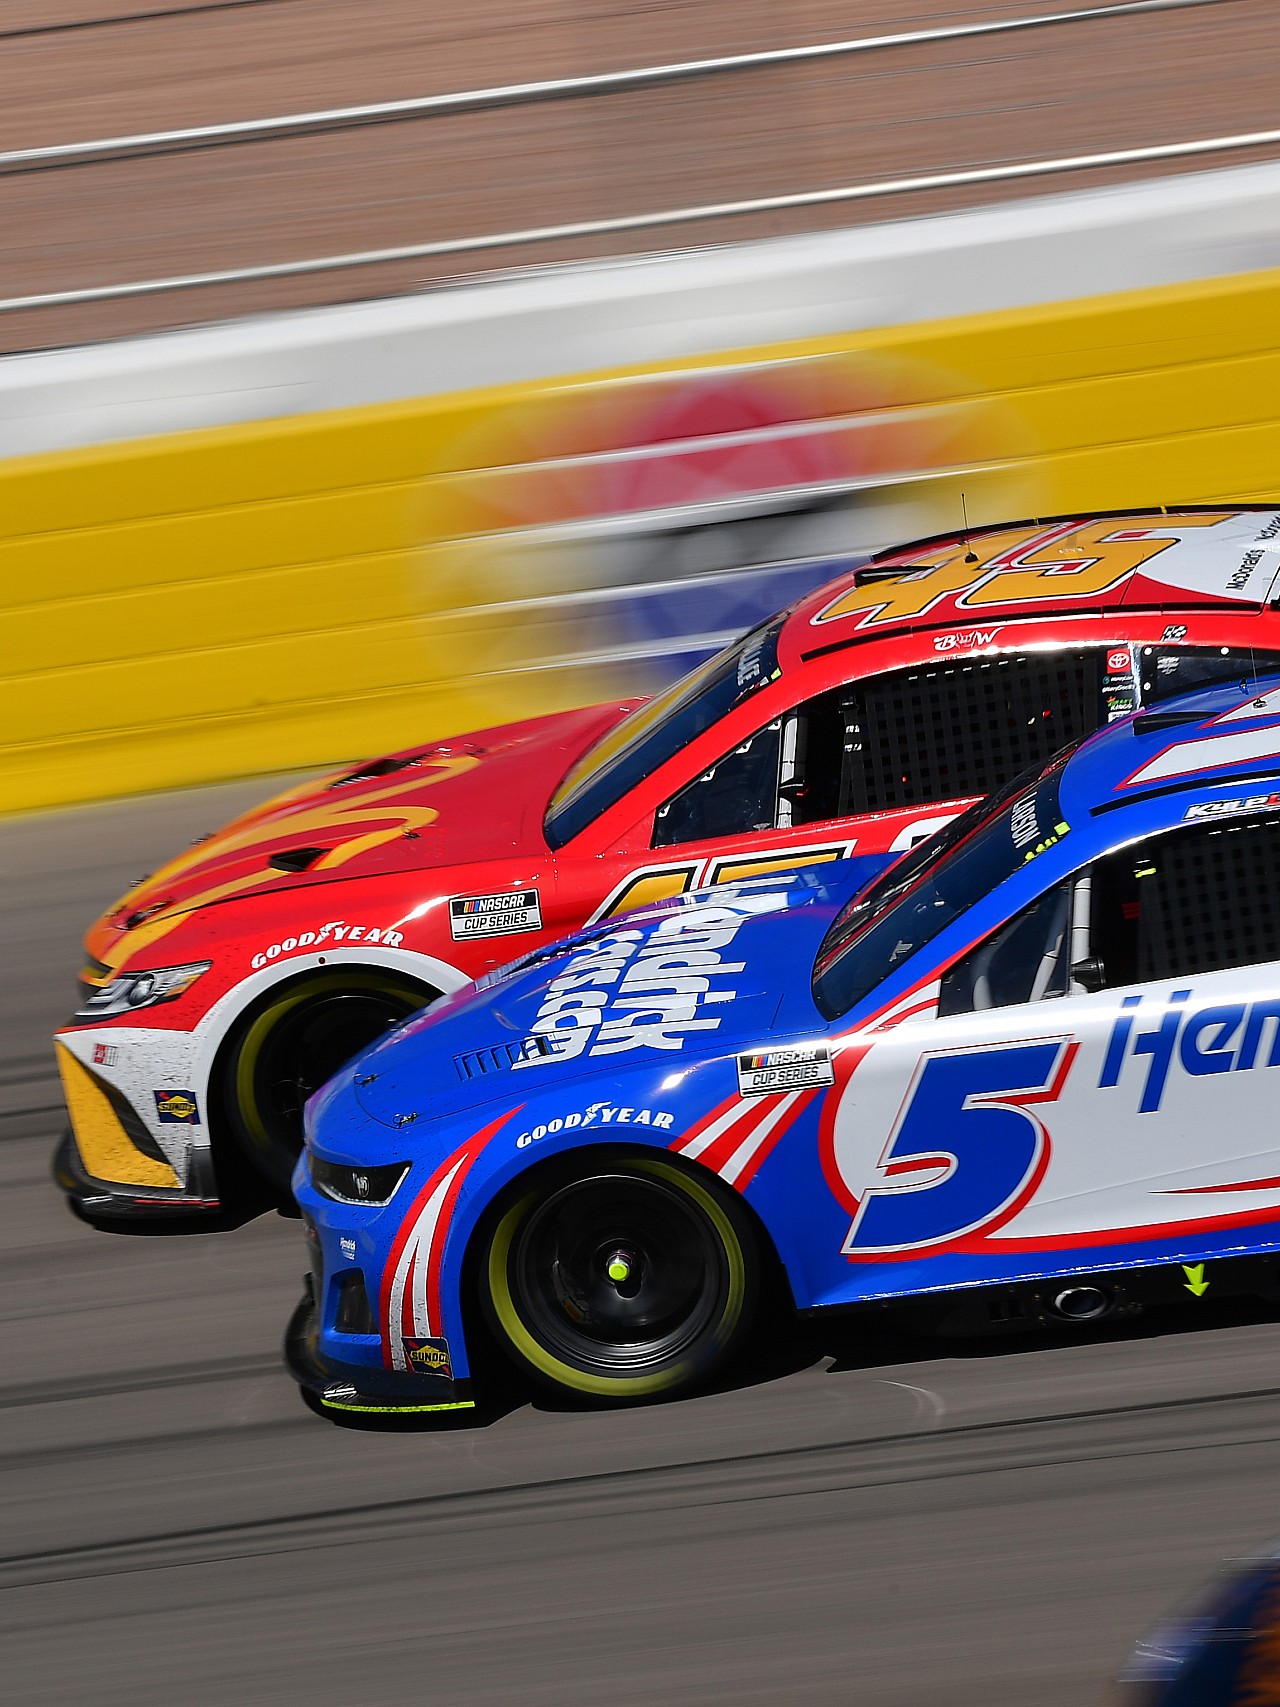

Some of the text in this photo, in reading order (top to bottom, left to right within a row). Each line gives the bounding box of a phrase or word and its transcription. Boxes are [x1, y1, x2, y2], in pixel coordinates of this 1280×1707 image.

[810, 512, 1246, 631] 45
[1010, 790, 1042, 850] LARSON
[464, 911, 528, 930] CUP SERIES
[479, 894, 526, 912] NASCAR
[251, 920, 404, 969] GOODYEAR
[751, 1066, 820, 1087] CUP SERIES
[765, 1048, 817, 1066] NASCAR
[516, 1101, 675, 1149] GOODYEAR
[840, 1033, 1081, 1263] 5
